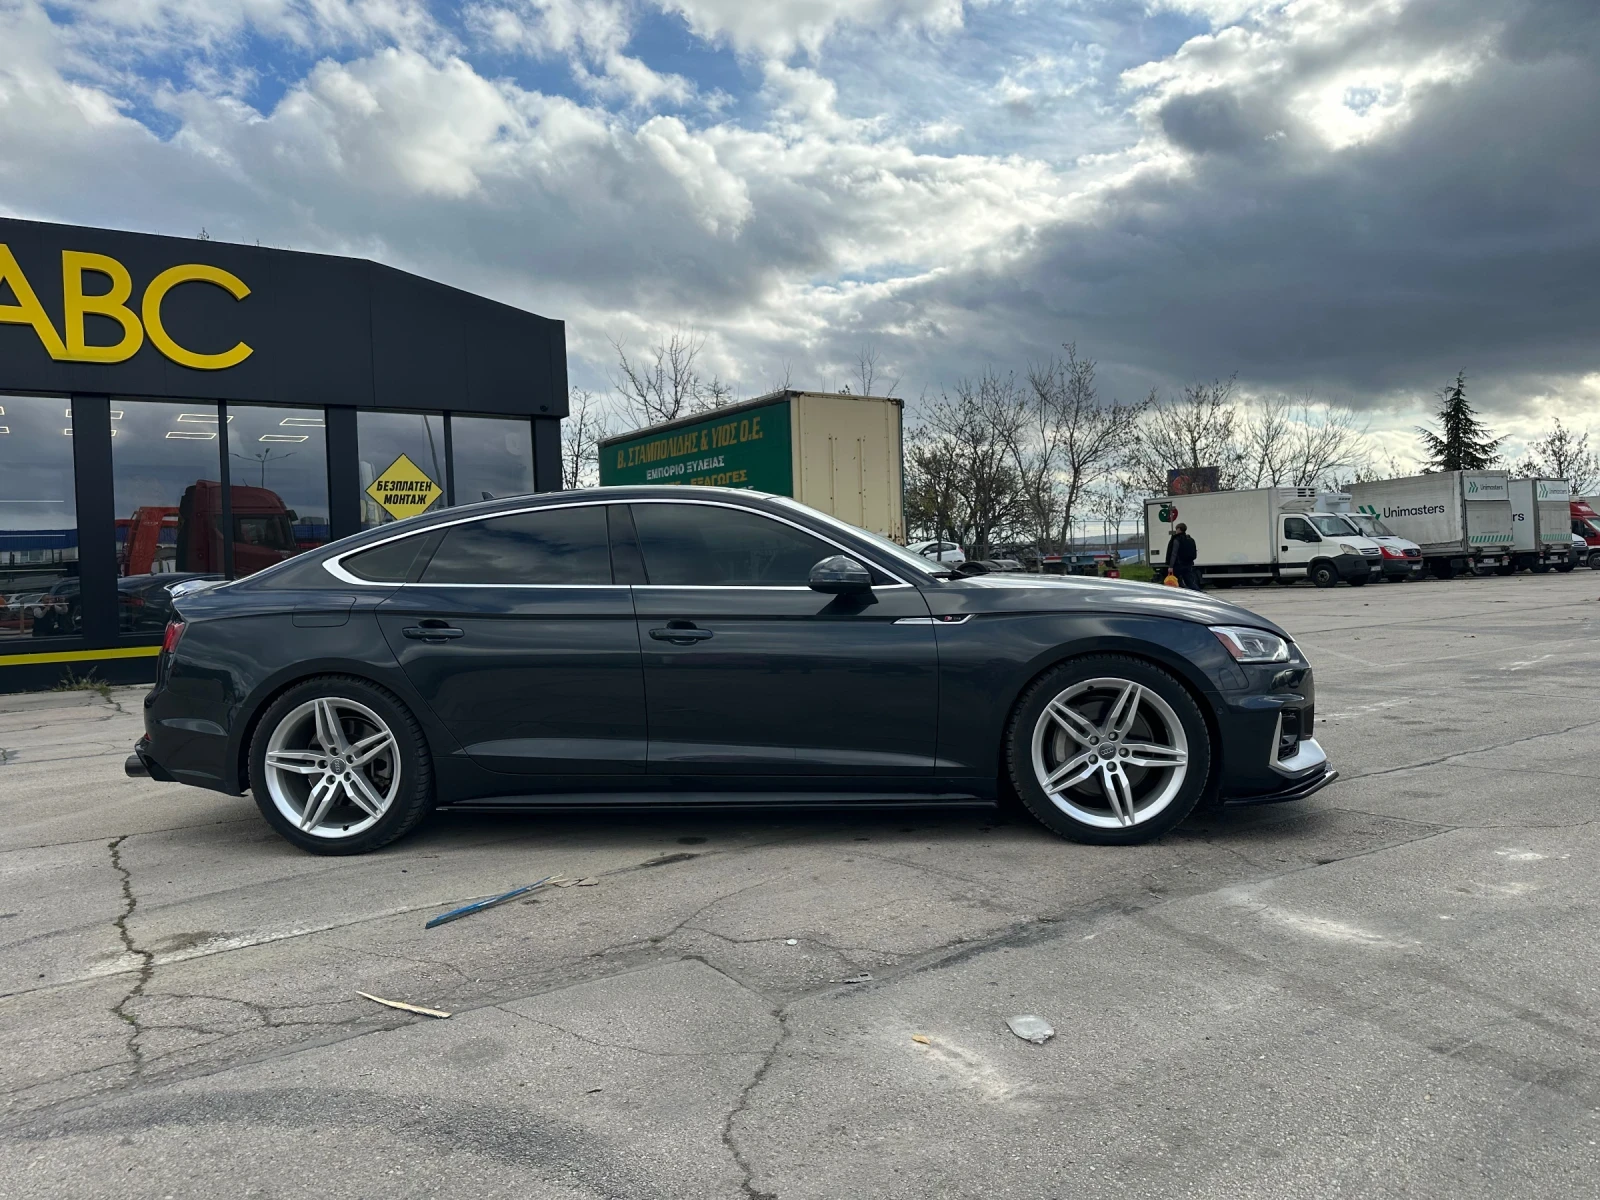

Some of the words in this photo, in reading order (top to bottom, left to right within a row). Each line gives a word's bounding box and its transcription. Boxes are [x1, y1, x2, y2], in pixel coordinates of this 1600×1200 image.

[0, 243, 254, 370] ABC
[701, 429, 709, 451] &
[712, 422, 737, 449] ΥΙΟΣ
[646, 463, 685, 481] ΕΜΠΟΡΙΟ
[686, 455, 725, 473] ΞΥΛΕΙΑΣ
[376, 480, 432, 492] БЕЗПЛАТЕН
[383, 494, 427, 505] МОНТАЖ
[1383, 504, 1445, 519] Unimasters
